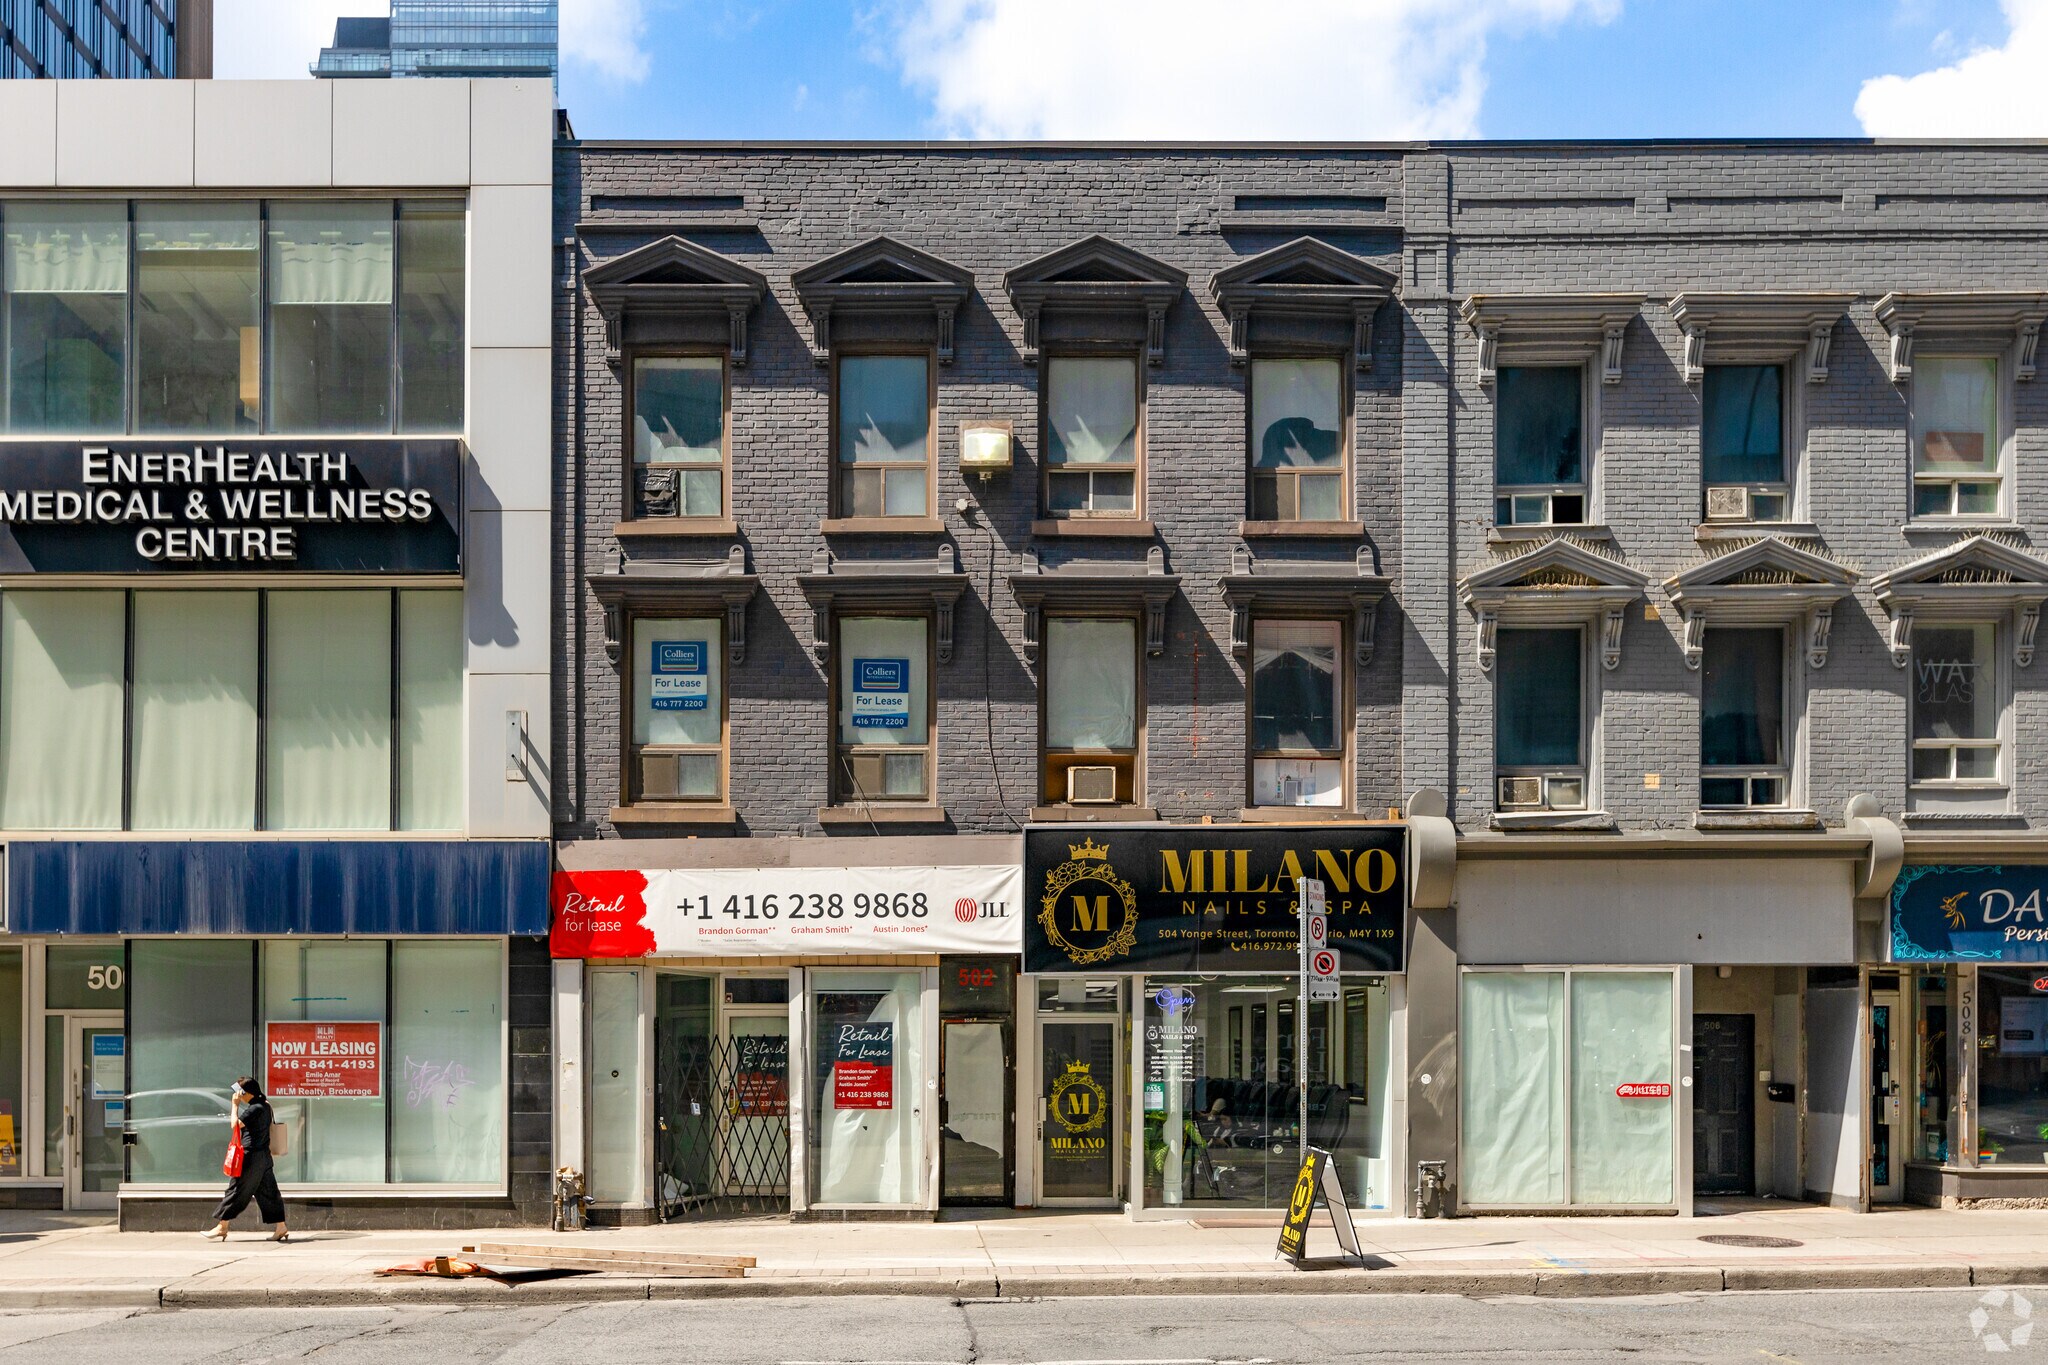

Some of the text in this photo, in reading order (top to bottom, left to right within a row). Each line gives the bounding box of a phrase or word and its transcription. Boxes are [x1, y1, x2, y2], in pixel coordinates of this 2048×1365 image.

[0, 488, 432, 521] MEDICAL & WELLNESS
[135, 526, 293, 559] CENTRE
[664, 649, 694, 658] Colliers
[866, 667, 896, 675] Colliers
[655, 678, 701, 687] For Lease
[856, 696, 903, 705] For Lease
[1159, 848, 1397, 894] MILANO
[1313, 882, 1320, 891] NO
[562, 892, 626, 915] Retail
[1309, 892, 1325, 902] STANDING
[677, 892, 929, 920] +1 416 238 9868
[978, 902, 1010, 918] JLL
[1182, 900, 1372, 915] NAILS & SPA
[1980, 888, 2048, 924] DA
[1070, 895, 1111, 932] M
[565, 918, 622, 932] for lease
[698, 926, 734, 935] Brandon
[791, 926, 824, 934] Graham
[873, 925, 899, 933] Austin
[1158, 929, 1177, 938] 504
[1180, 929, 1213, 940] Yonge
[1216, 929, 1252, 939] Street,
[1255, 929, 1299, 939] Toronto,
[1349, 929, 1371, 938] M4Y
[1376, 929, 1395, 938] 1X9
[87, 965, 125, 990] 50
[959, 968, 993, 987] 502
[1155, 989, 1196, 1016] Open
[1962, 991, 1971, 1035] 508
[317, 1026, 334, 1035] MLM
[838, 1024, 890, 1043] Retail
[1158, 1025, 1197, 1034] MILANO
[271, 1042, 376, 1055] NOW LEASING
[838, 1043, 890, 1059] For Lease
[298, 1088, 327, 1096] Realty,
[329, 1088, 372, 1096] Brokerage
[1066, 1093, 1091, 1115] M
[1050, 1137, 1106, 1149] MILANO
